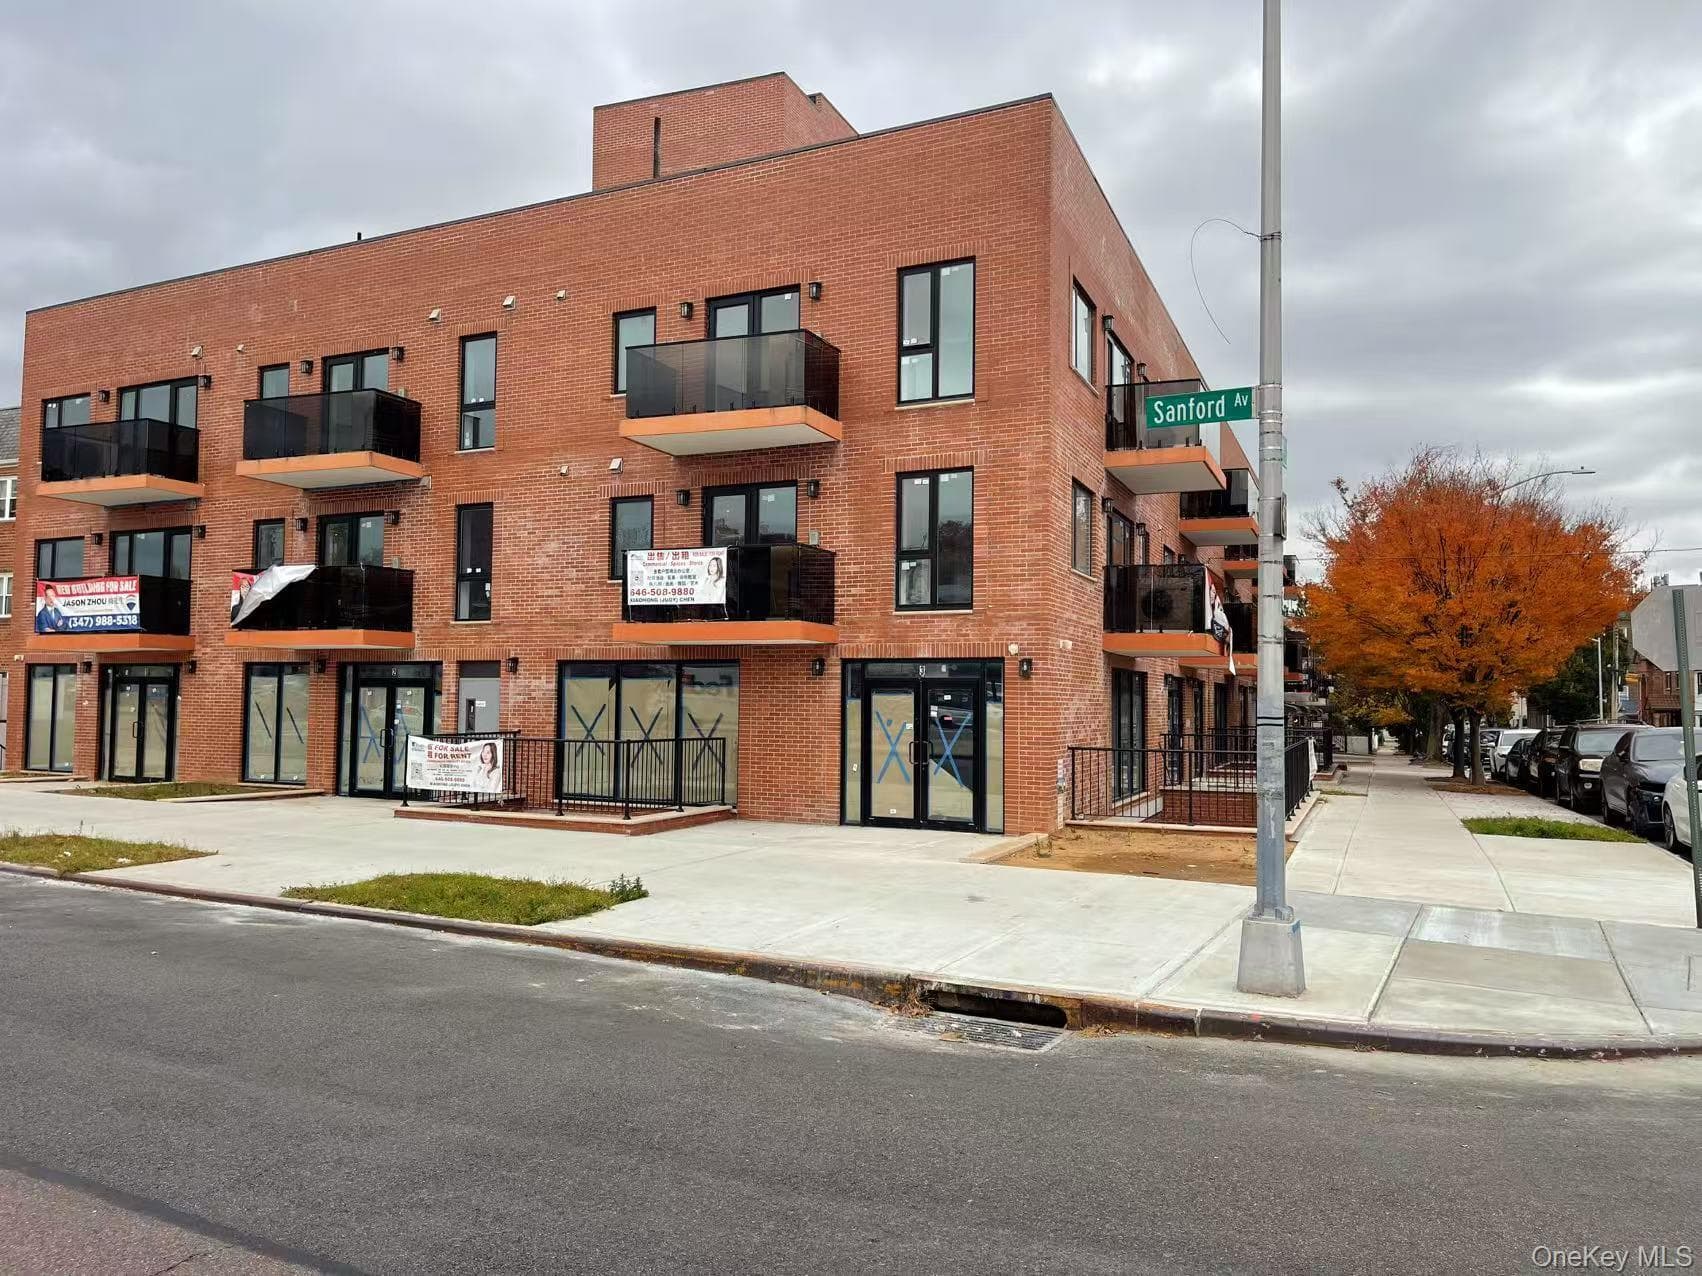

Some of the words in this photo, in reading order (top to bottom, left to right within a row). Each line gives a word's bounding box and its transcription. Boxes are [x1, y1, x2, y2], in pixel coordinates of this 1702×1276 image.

[1154, 395, 1225, 424] Sanford
[1234, 393, 1249, 407] Av
[106, 580, 119, 593] FOR
[119, 579, 137, 592] SALE
[62, 598, 86, 607] JASON
[87, 598, 107, 606] ZHOU
[68, 616, 93, 628] (347)
[95, 615, 138, 626] 988-5318
[434, 744, 448, 752] FOR
[434, 752, 449, 760] FOR
[450, 752, 472, 760] RENT
